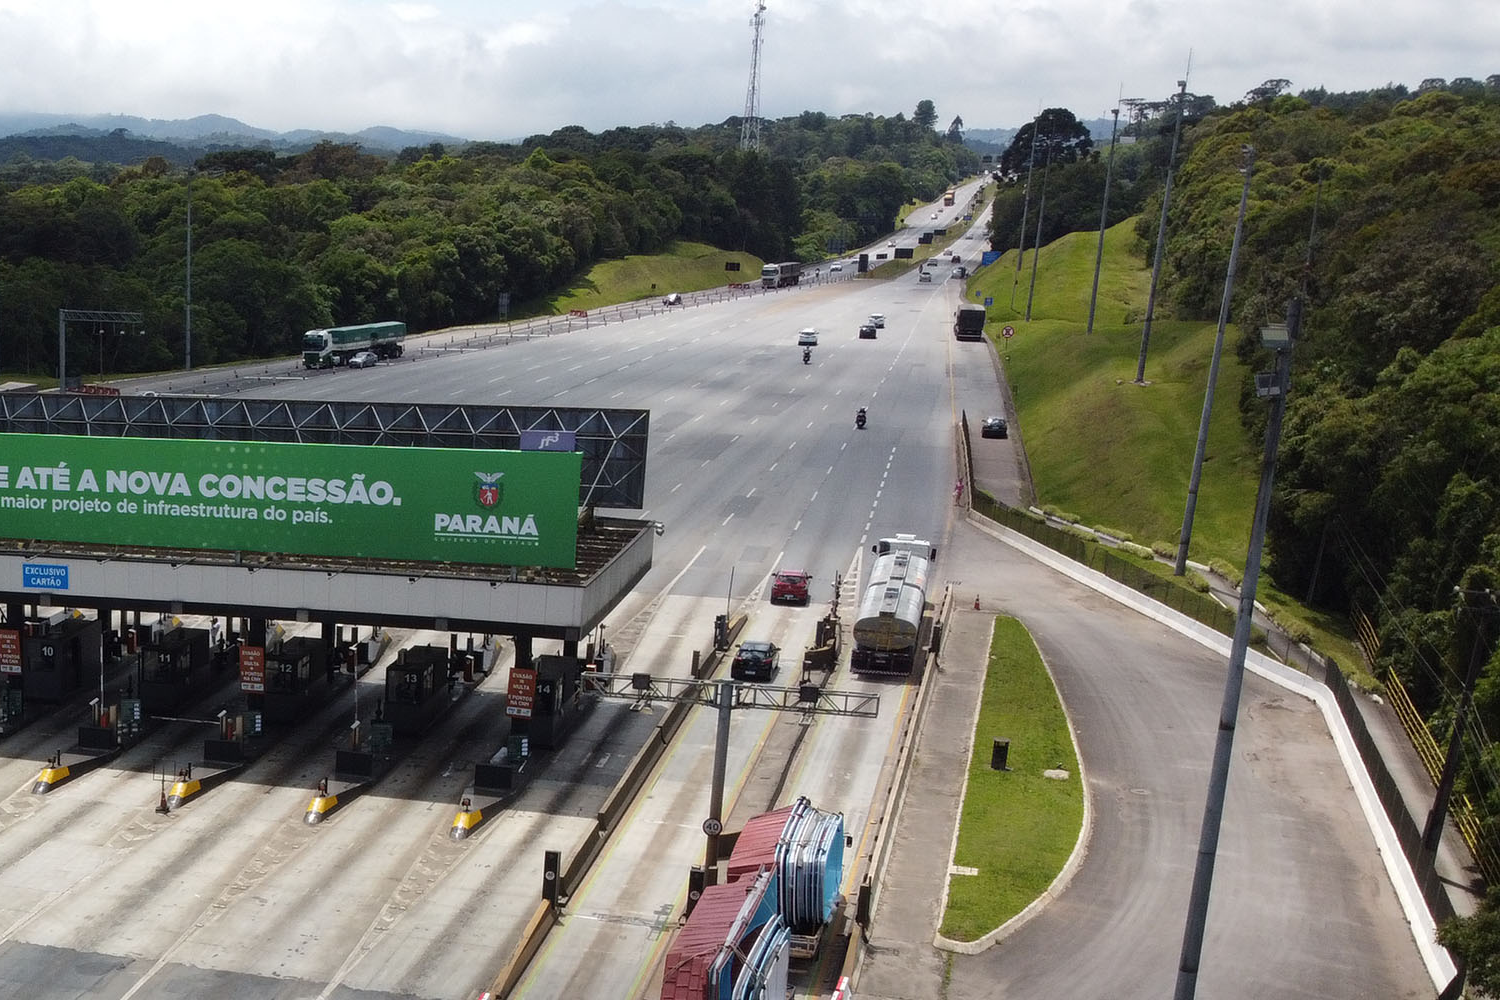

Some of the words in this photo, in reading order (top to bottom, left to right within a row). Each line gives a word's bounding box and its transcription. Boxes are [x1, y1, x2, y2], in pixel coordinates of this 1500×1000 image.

[15, 461, 70, 491] ATÉ
[76, 469, 100, 493] A
[106, 470, 192, 496] NOVA
[198, 473, 402, 506] CONCESSÃO.
[1, 494, 47, 510] maior
[52, 496, 112, 514] projeto
[116, 498, 138, 514] de
[143, 499, 258, 519] infraestrutura
[263, 505, 287, 521] do
[292, 507, 333, 525] país.
[434, 513, 539, 536] PARANÁ
[25, 566, 66, 576] EXCLUSIVO
[30, 576, 62, 587] CARTÃO
[41, 646, 54, 656] 10
[159, 653, 170, 663] 11
[279, 663, 293, 673] 12
[404, 673, 418, 683] 13
[537, 685, 550, 693] 14
[706, 822, 719, 831] 40
